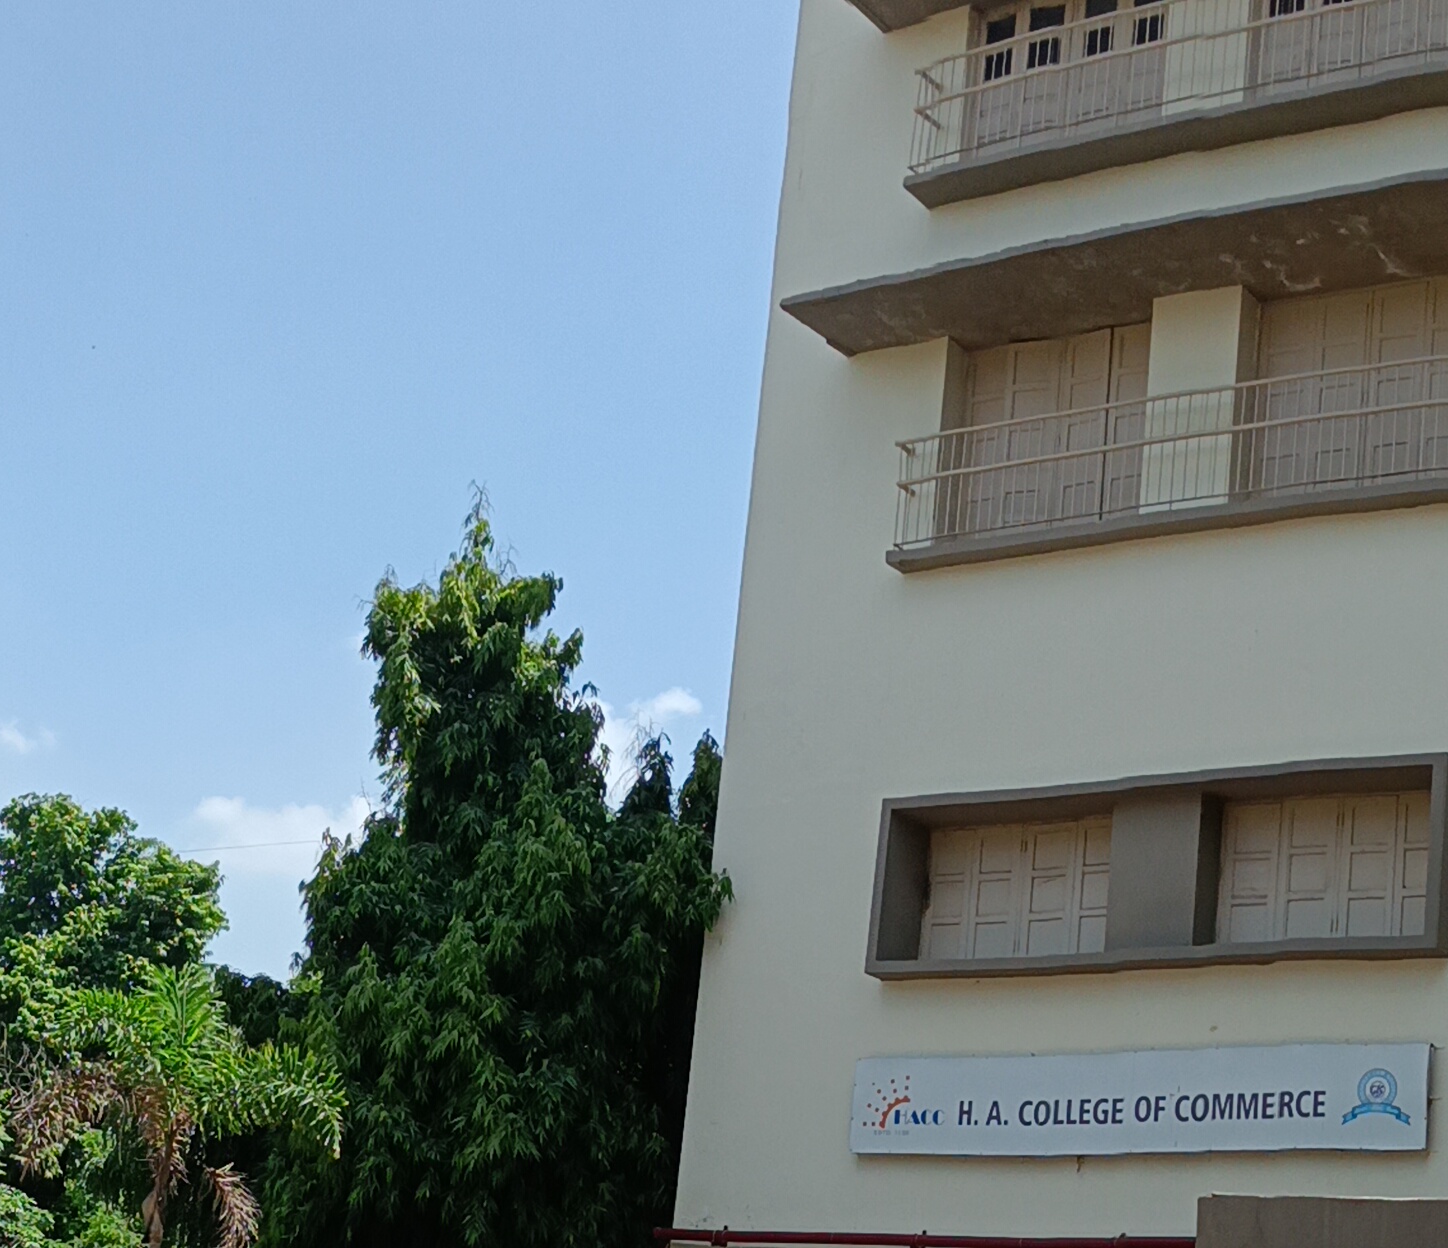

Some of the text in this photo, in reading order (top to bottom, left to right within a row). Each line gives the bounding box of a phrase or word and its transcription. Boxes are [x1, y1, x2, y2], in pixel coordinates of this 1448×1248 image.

[894, 1108, 945, 1126] HACC
[957, 1090, 1327, 1127] H. A. COLLEGE OF COMMERCE
